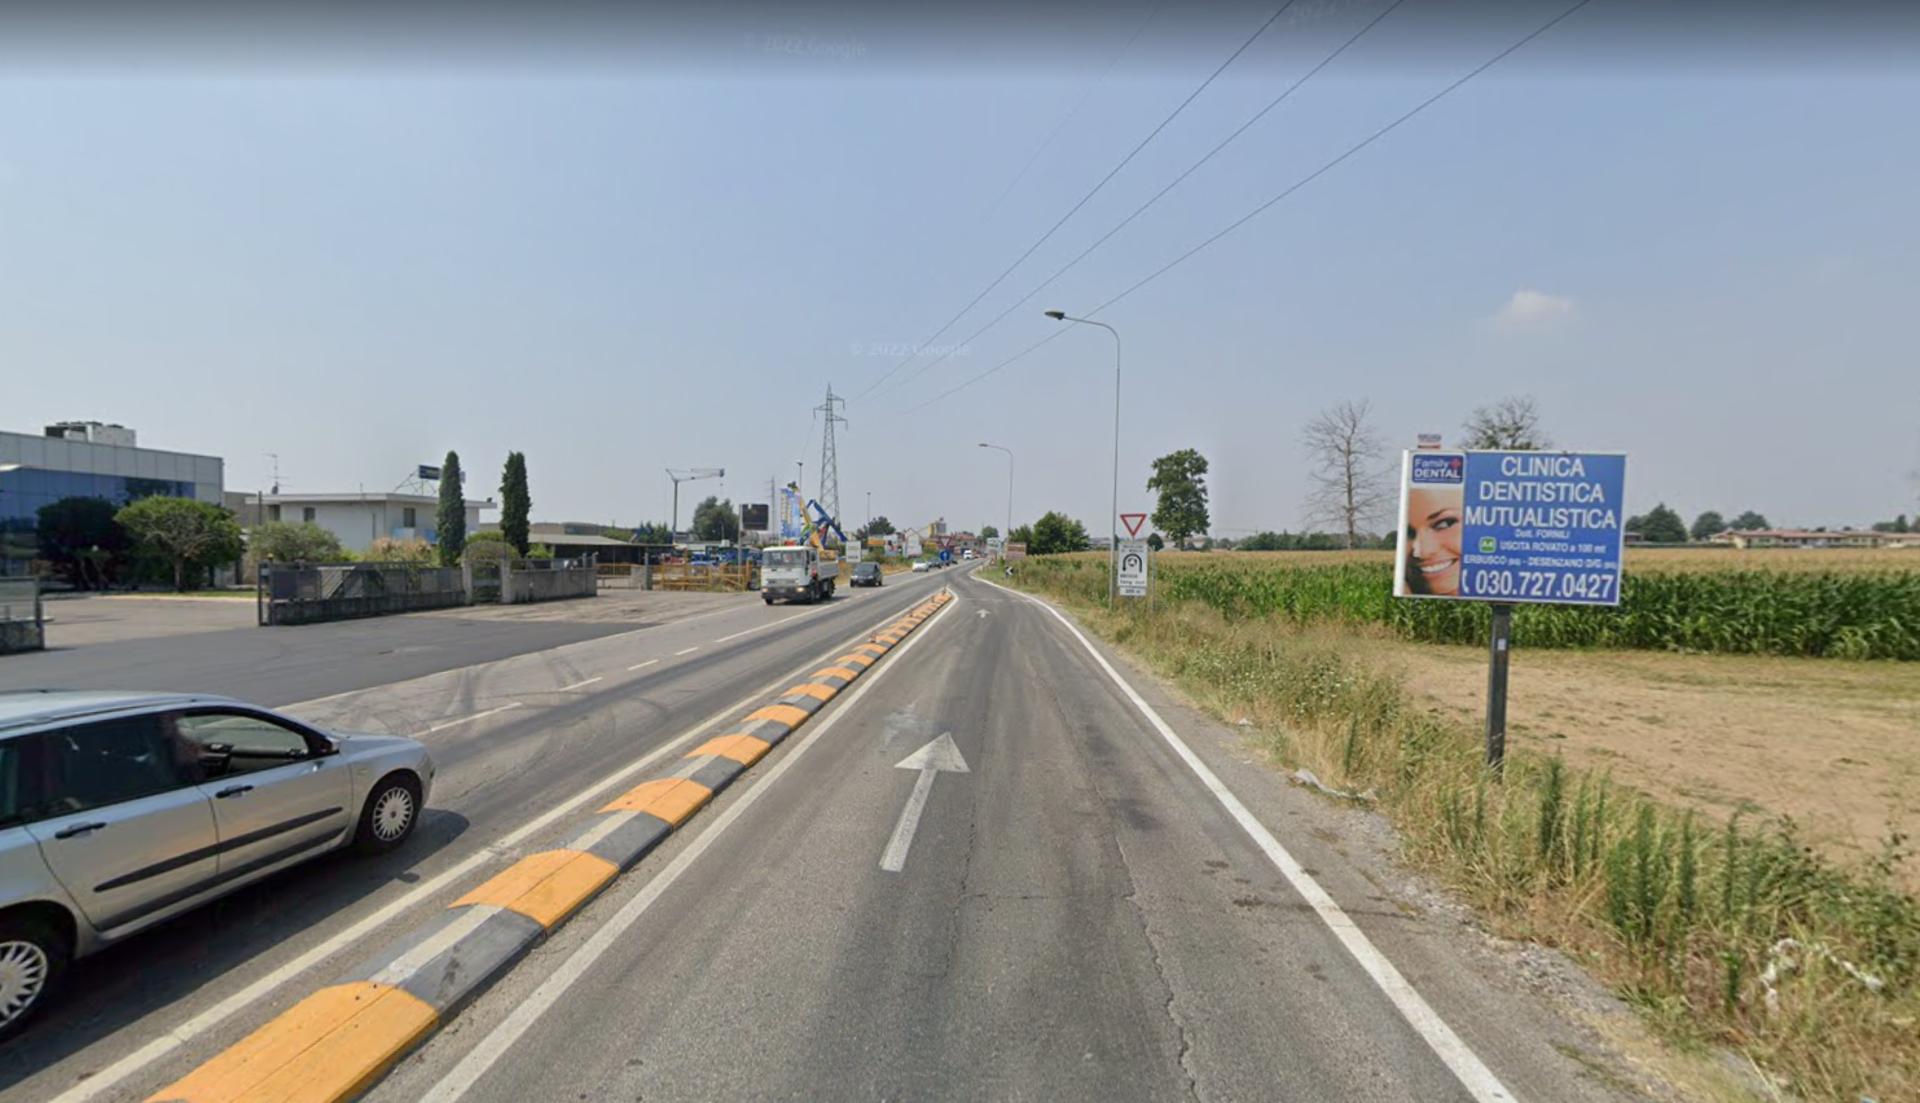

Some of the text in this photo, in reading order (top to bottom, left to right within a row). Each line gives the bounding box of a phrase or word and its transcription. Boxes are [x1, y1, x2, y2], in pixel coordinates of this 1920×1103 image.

[1414, 468, 1462, 479] DENTAL
[1501, 456, 1584, 476] CLINICA
[1479, 481, 1604, 502] DENTISTICA
[1465, 506, 1617, 528] MUTUALISTICA
[1499, 540, 1530, 550] USCITA
[1531, 542, 1568, 551] ROVATO
[1463, 554, 1507, 564] ERBUSCO
[1527, 556, 1583, 567] DESENZANO
[1475, 570, 1614, 597] 030.727.0427
